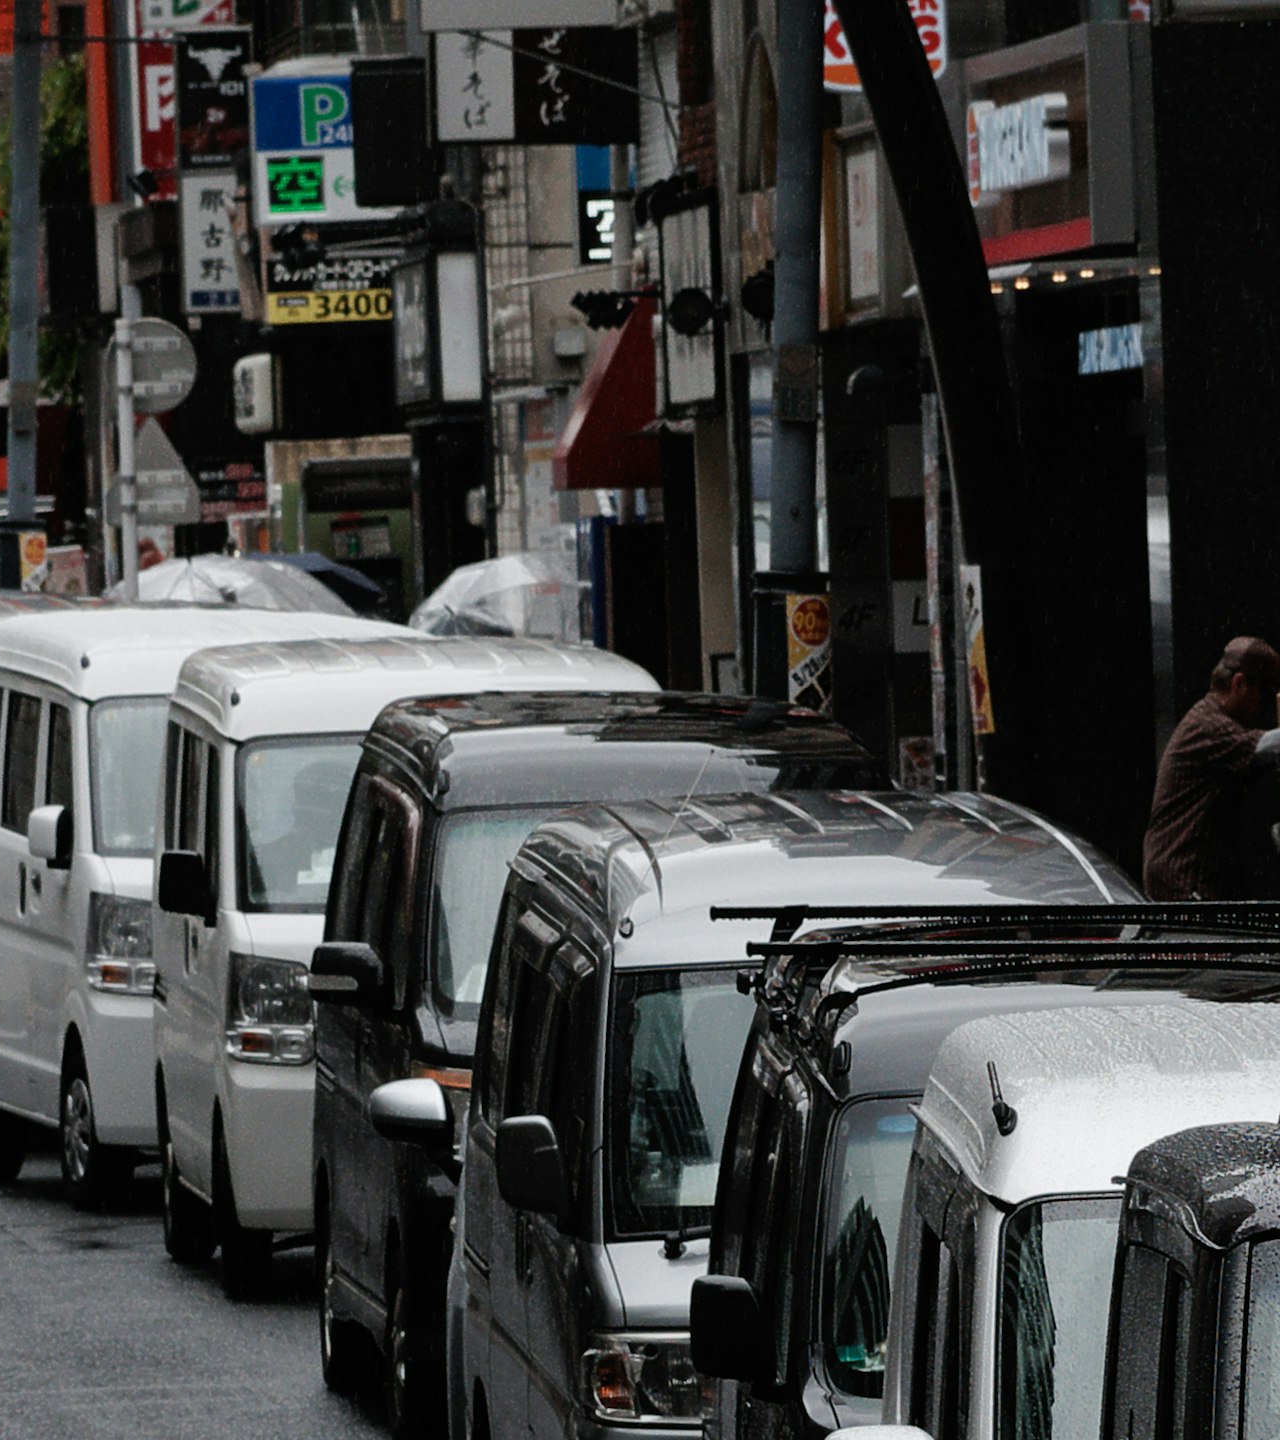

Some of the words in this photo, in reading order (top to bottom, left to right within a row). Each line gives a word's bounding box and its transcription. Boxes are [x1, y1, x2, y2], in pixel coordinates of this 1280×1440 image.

[299, 83, 348, 146] P
[267, 156, 325, 213] 空
[315, 293, 391, 318] 3400
